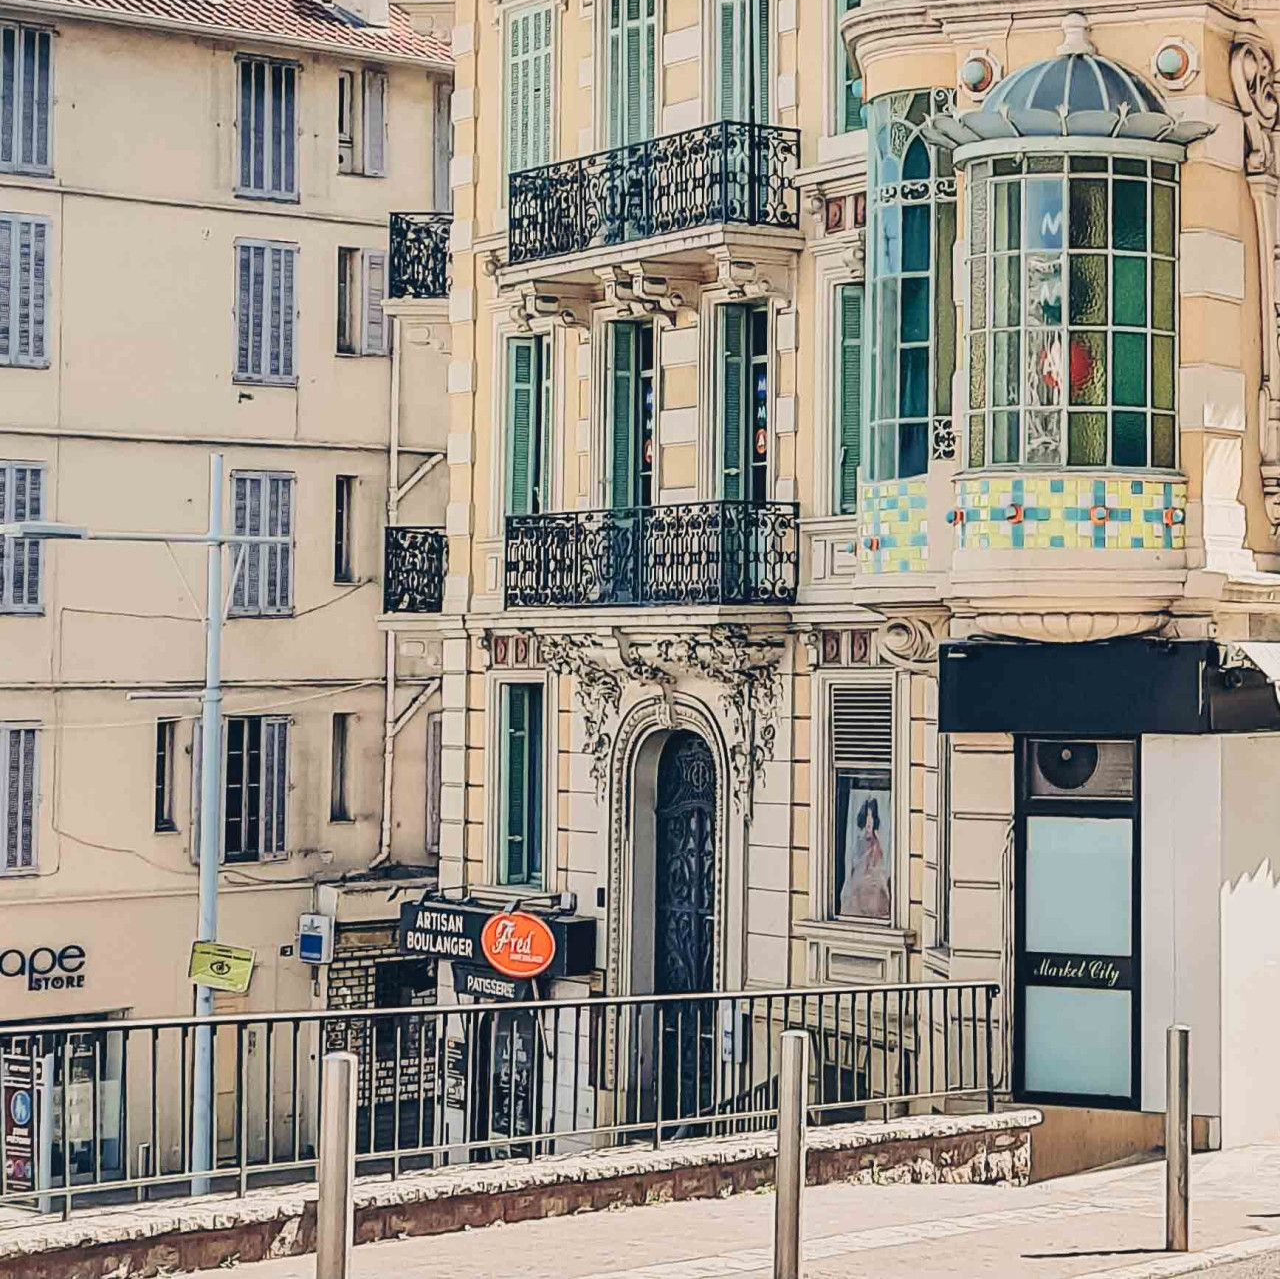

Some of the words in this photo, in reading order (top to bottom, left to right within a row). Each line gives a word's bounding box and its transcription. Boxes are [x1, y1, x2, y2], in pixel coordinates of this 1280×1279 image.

[416, 910, 464, 934] ARTISAN
[406, 931, 473, 959] BOULANGER
[491, 919, 535, 954] Fred
[32, 974, 85, 990] STORE
[1034, 958, 1086, 978] Market
[1088, 960, 1120, 987] City
